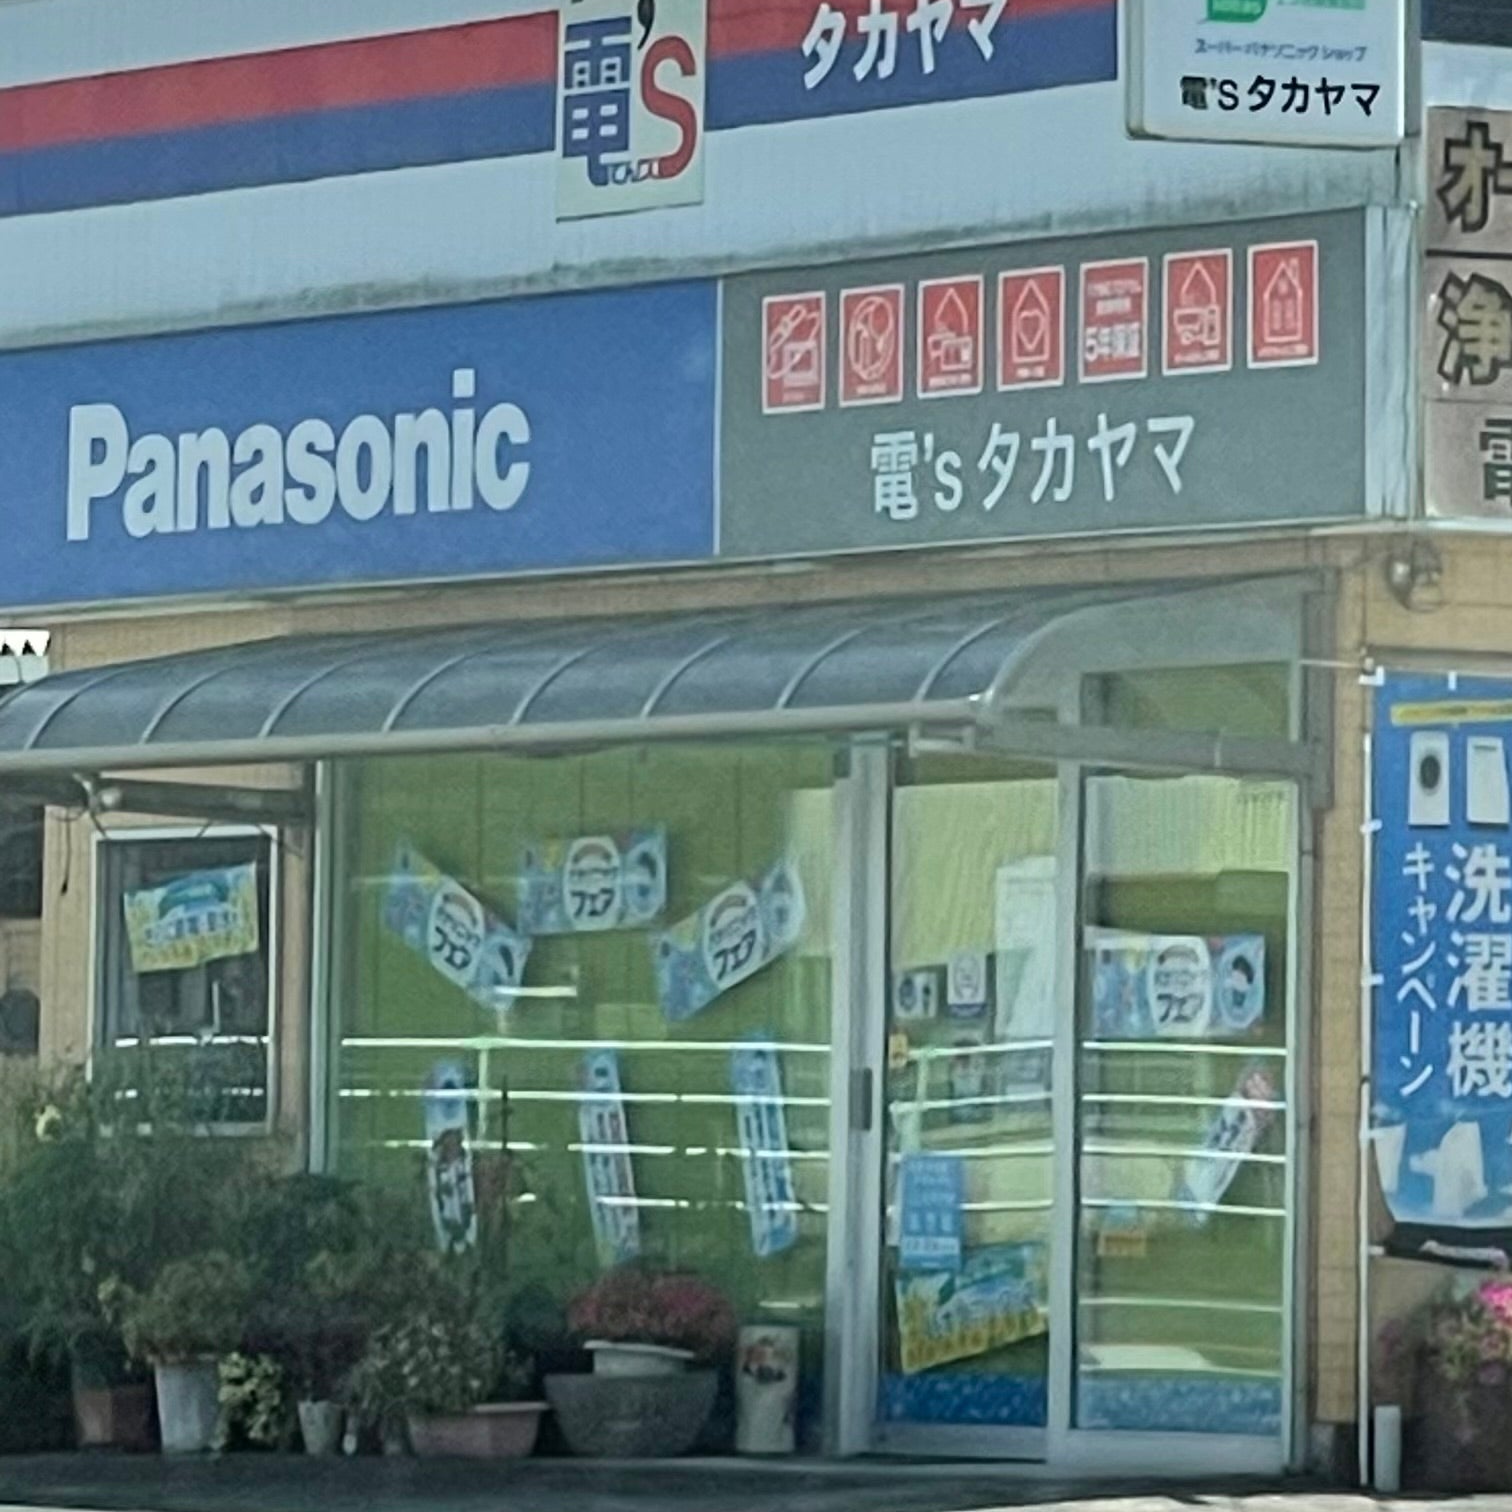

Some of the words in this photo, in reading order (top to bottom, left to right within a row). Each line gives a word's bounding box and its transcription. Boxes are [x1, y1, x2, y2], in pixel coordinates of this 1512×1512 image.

[66, 368, 531, 541] Panasonic
[1397, 842, 1437, 1096] キャンペーン
